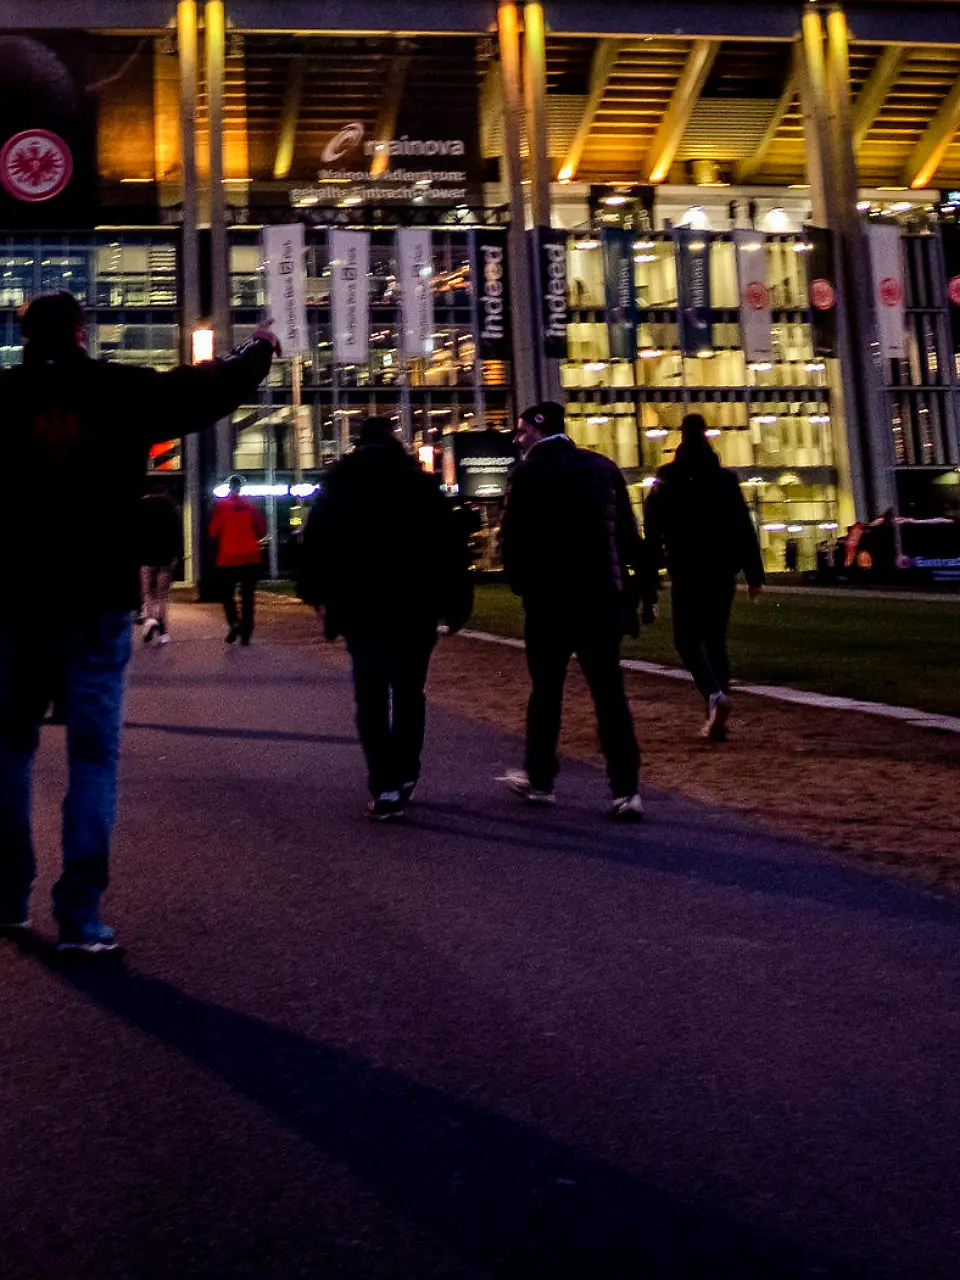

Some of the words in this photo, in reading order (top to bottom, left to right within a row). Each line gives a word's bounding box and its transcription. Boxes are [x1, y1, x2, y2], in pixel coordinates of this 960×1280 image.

[364, 135, 465, 156] mainova
[480, 245, 504, 339] indeed
[543, 244, 567, 337] indeed
